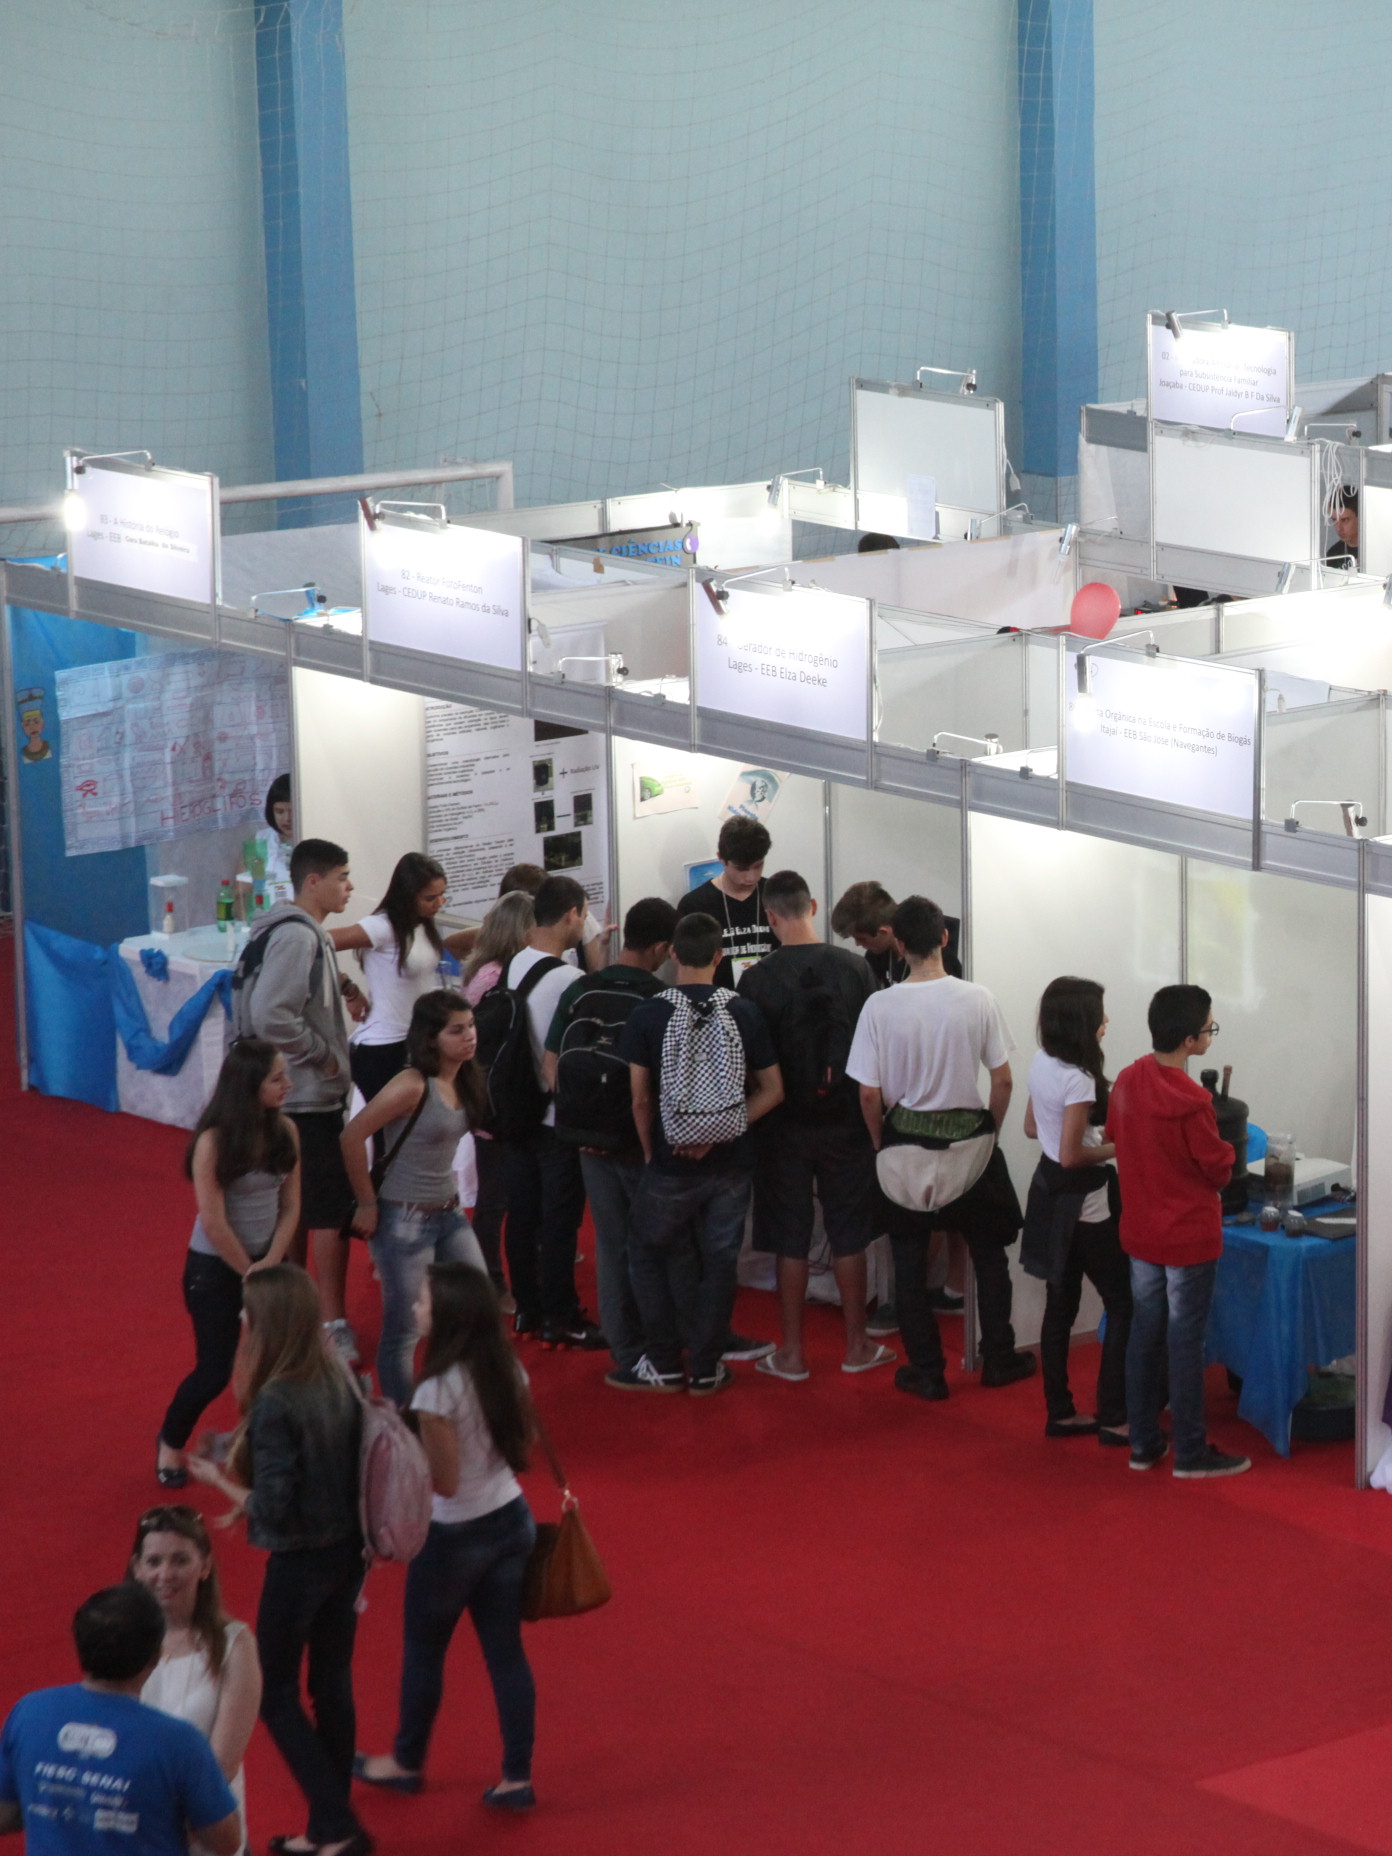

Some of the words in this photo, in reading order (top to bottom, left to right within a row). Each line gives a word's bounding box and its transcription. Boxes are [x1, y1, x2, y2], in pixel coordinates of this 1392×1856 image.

[1161, 351, 1170, 361] 02
[1159, 378, 1184, 390] Joaçaba
[1188, 382, 1210, 394] CEDUP
[1211, 386, 1224, 396] Prof
[1256, 391, 1265, 401] Da
[1265, 393, 1281, 404] Silva
[1179, 368, 1194, 378] para
[1233, 375, 1259, 387] Familiar
[611, 539, 683, 557] CIÊNCIAS
[401, 568, 411, 581] 82
[416, 572, 440, 586] Reator
[441, 577, 483, 595] FotoFenton
[376, 582, 397, 596] Lages
[402, 586, 428, 600] CEDUP
[429, 592, 454, 607] Renato
[455, 597, 480, 612] Ramos
[481, 602, 491, 614] da
[492, 604, 509, 618] Silva
[717, 633, 728, 647] 84
[774, 646, 787, 659] de
[788, 648, 839, 669] Hidrogênio
[728, 656, 752, 674] Lages
[760, 663, 777, 677] EEB
[779, 666, 797, 682] Elza
[799, 670, 828, 688] Deeke
[1105, 708, 1137, 724] Orgânica
[1137, 716, 1147, 727] na
[1148, 717, 1171, 732] Escola
[1179, 723, 1216, 740] Formação
[1216, 728, 1226, 741] de
[1227, 731, 1252, 747] Biogás
[1124, 728, 1138, 740] EEB
[1139, 731, 1153, 743] São
[1170, 737, 1219, 757] (Navegantes)
